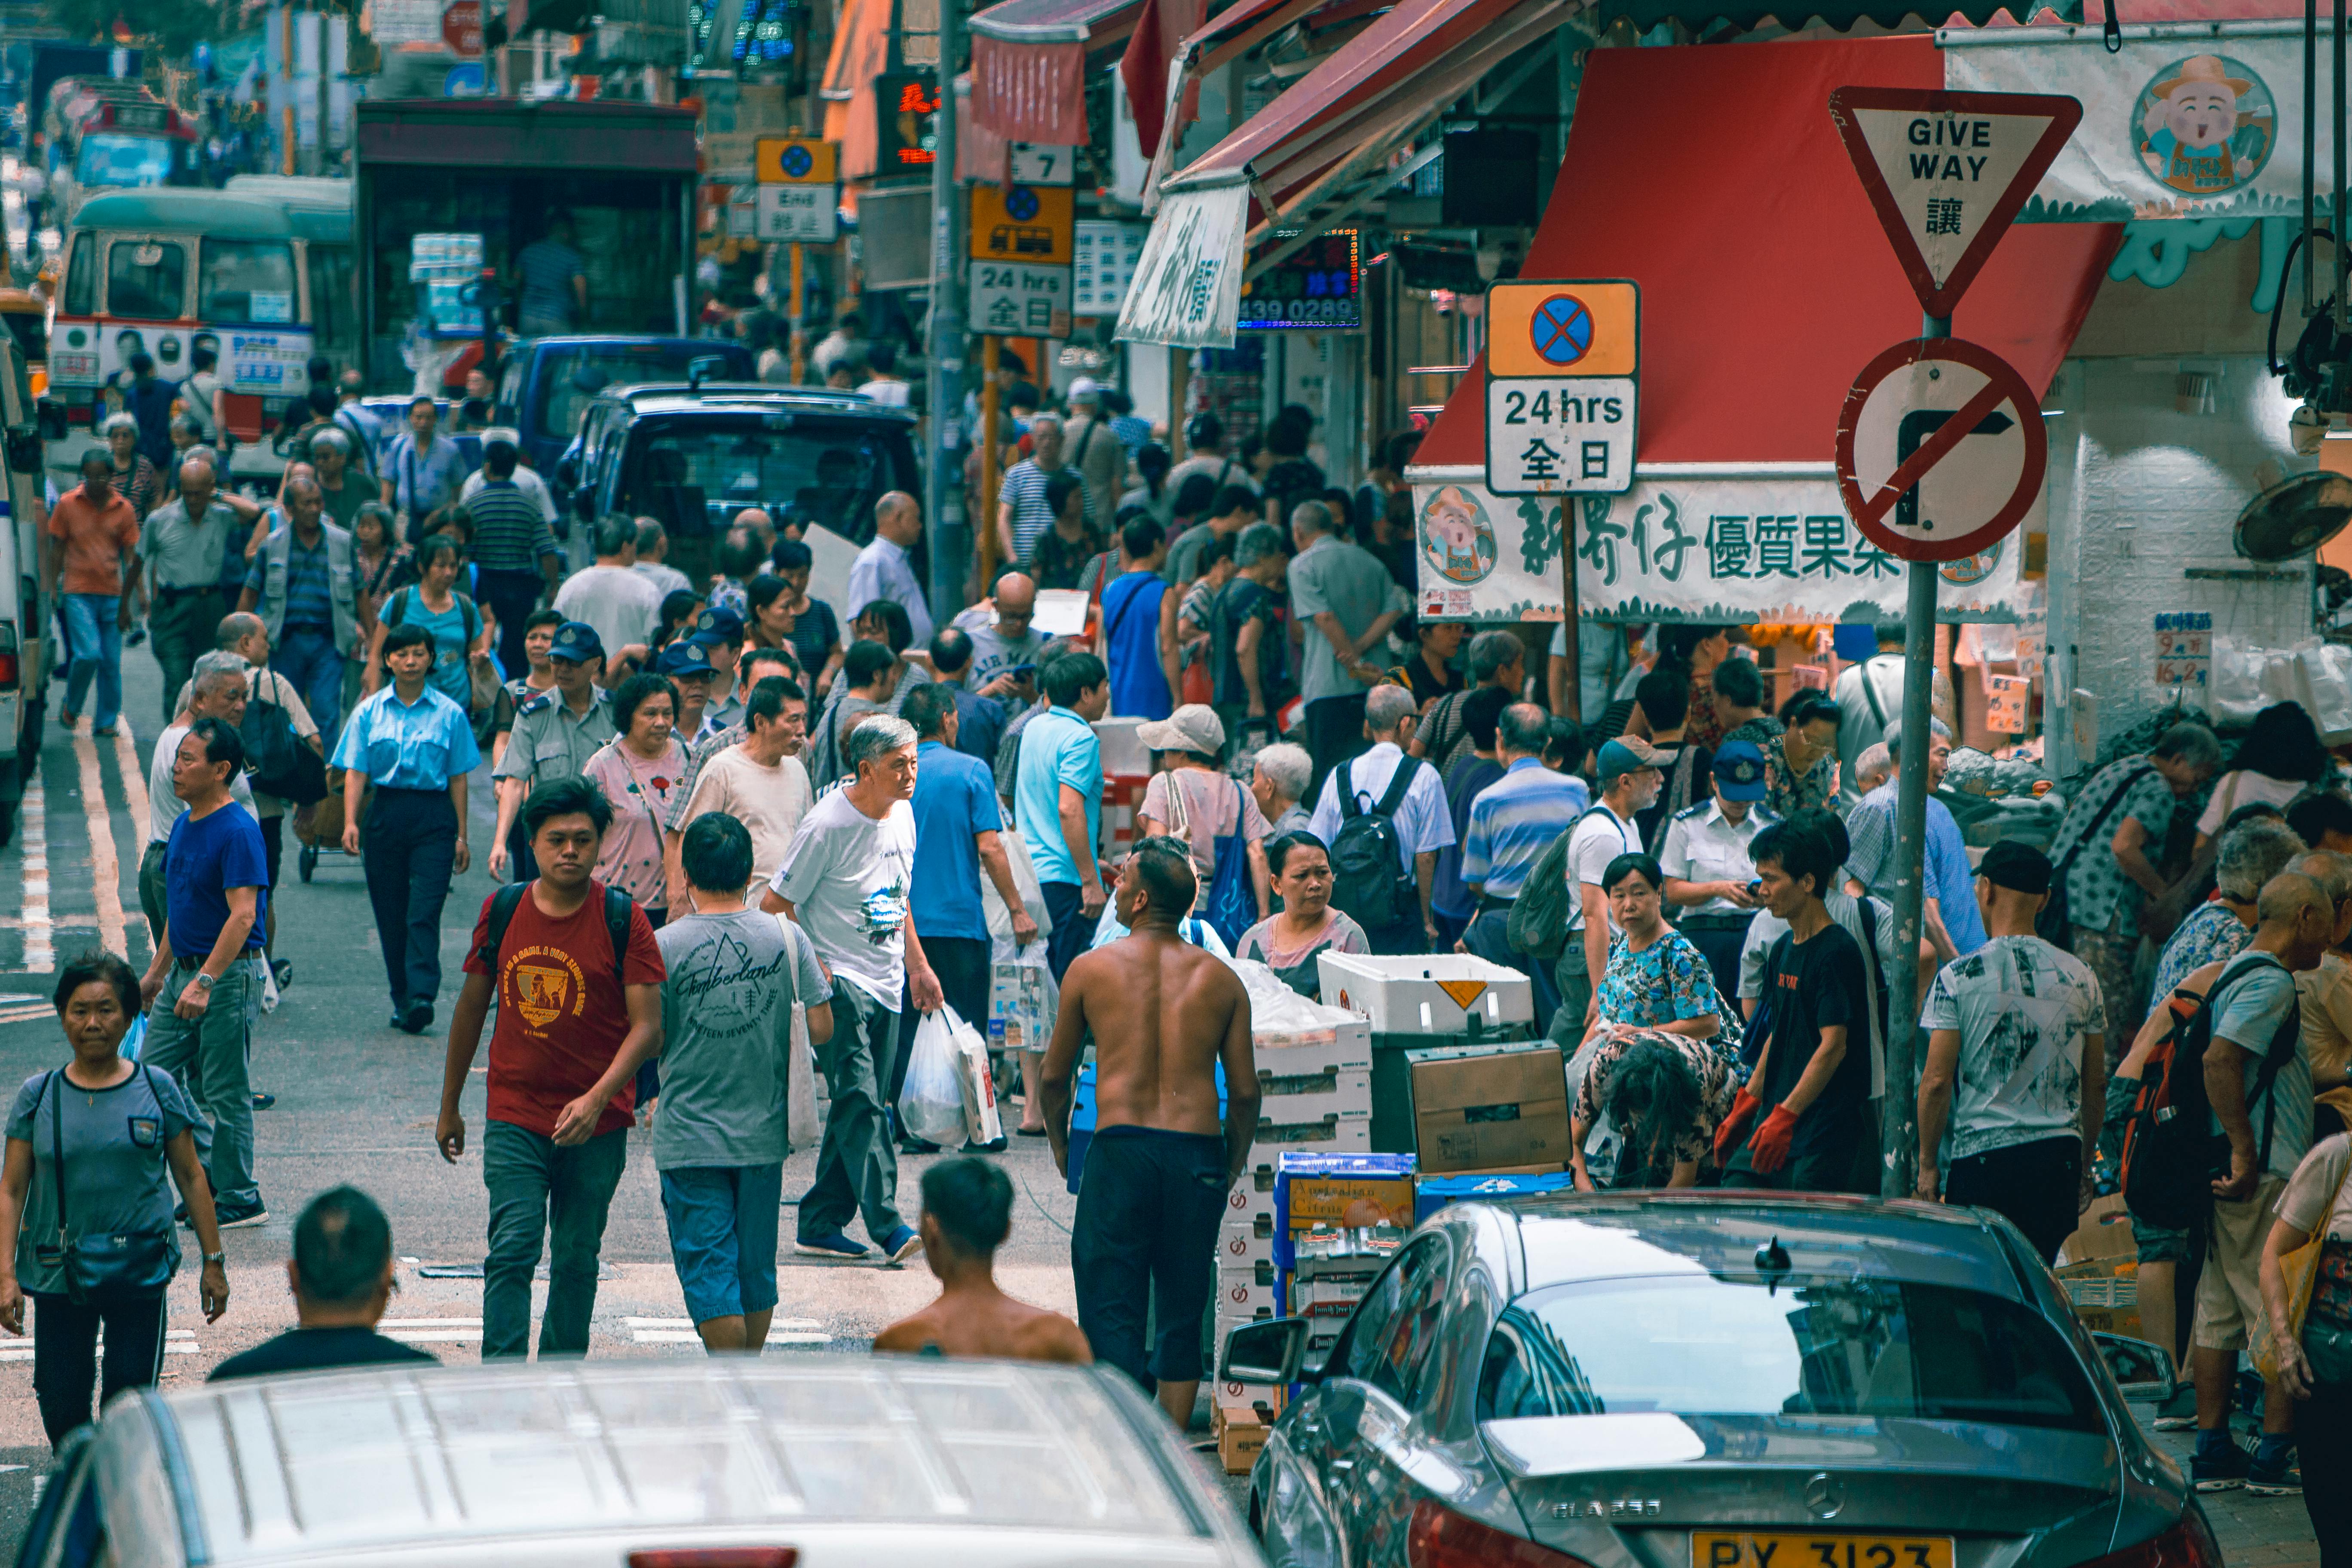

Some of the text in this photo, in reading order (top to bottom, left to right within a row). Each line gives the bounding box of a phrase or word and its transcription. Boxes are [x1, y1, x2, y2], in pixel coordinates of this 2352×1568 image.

[1908, 118, 1991, 147] GIVE
[1909, 153, 1988, 182] WAY
[1926, 197, 1963, 235] 讓
[982, 266, 1059, 292] 24 hrs
[1505, 389, 1623, 425] 24 hrs
[1520, 438, 1610, 481] 全日
[676, 950, 785, 998] Timberland
[1292, 1180, 1375, 1197] Australian
[1292, 1198, 1343, 1213] Citrus
[1314, 1304, 1334, 1315] Family
[1335, 1304, 1348, 1315] Tree
